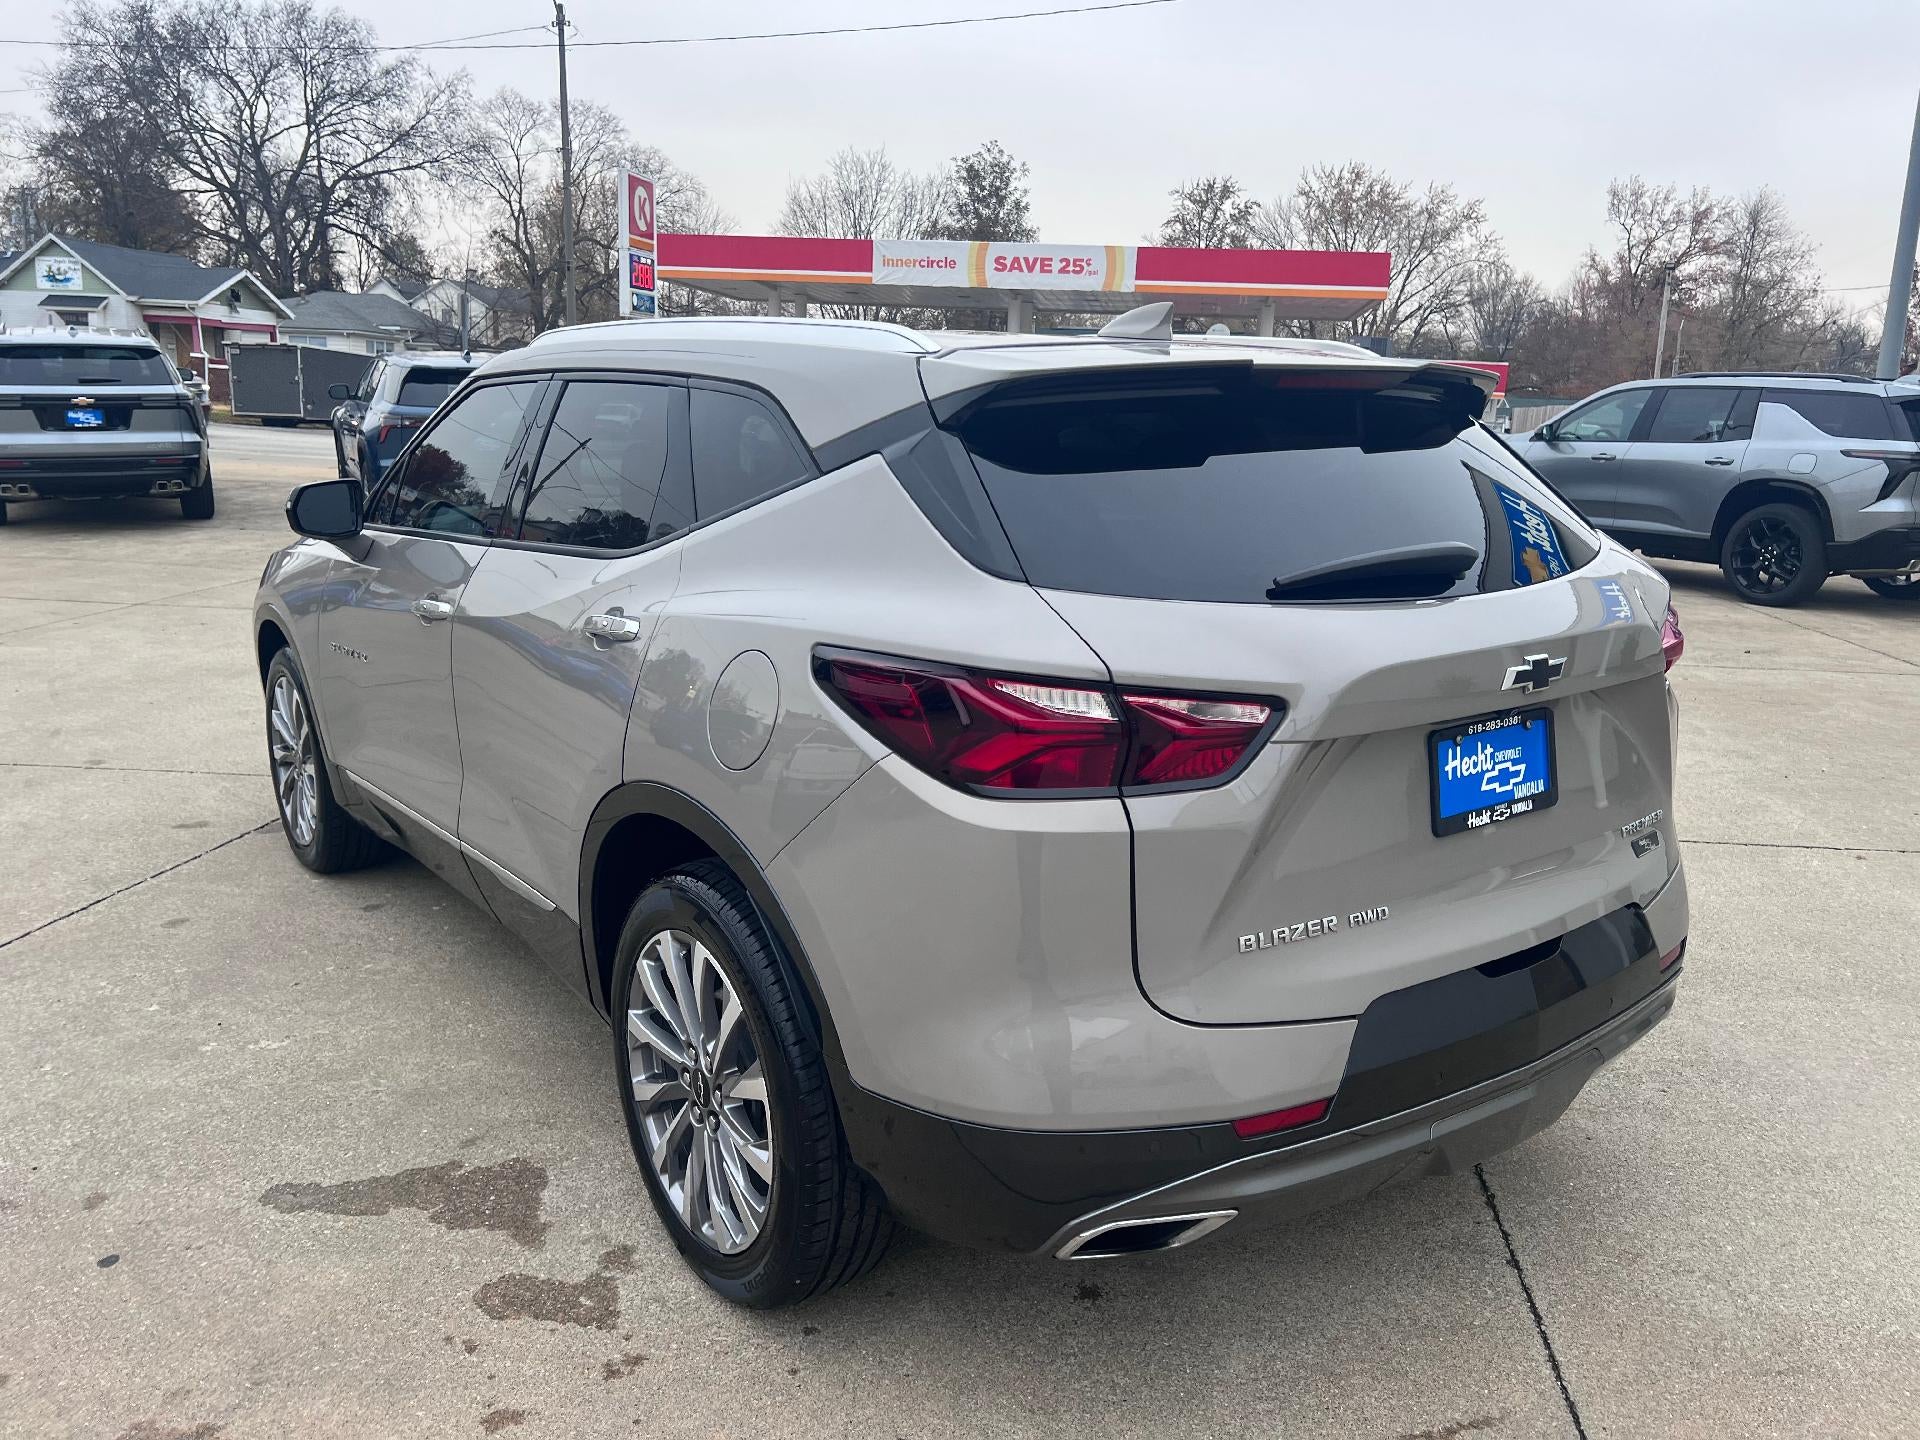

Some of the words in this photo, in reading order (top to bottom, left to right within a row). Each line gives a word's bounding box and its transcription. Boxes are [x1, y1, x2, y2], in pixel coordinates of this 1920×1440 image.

[636, 193, 652, 233] K
[882, 255, 957, 269] innercircle
[993, 256, 1053, 275] SAVE
[1468, 715, 1522, 735] 618-283-0381
[1445, 741, 1494, 781] Hecht
[1494, 747, 1522, 762] CHEVROLET
[1514, 779, 1545, 799] VANDALIA
[1467, 809, 1492, 829] Hecht
[1621, 809, 1663, 838] PREMIER
[1239, 915, 1338, 953] BLAZER
[1349, 906, 1390, 928] AWD
